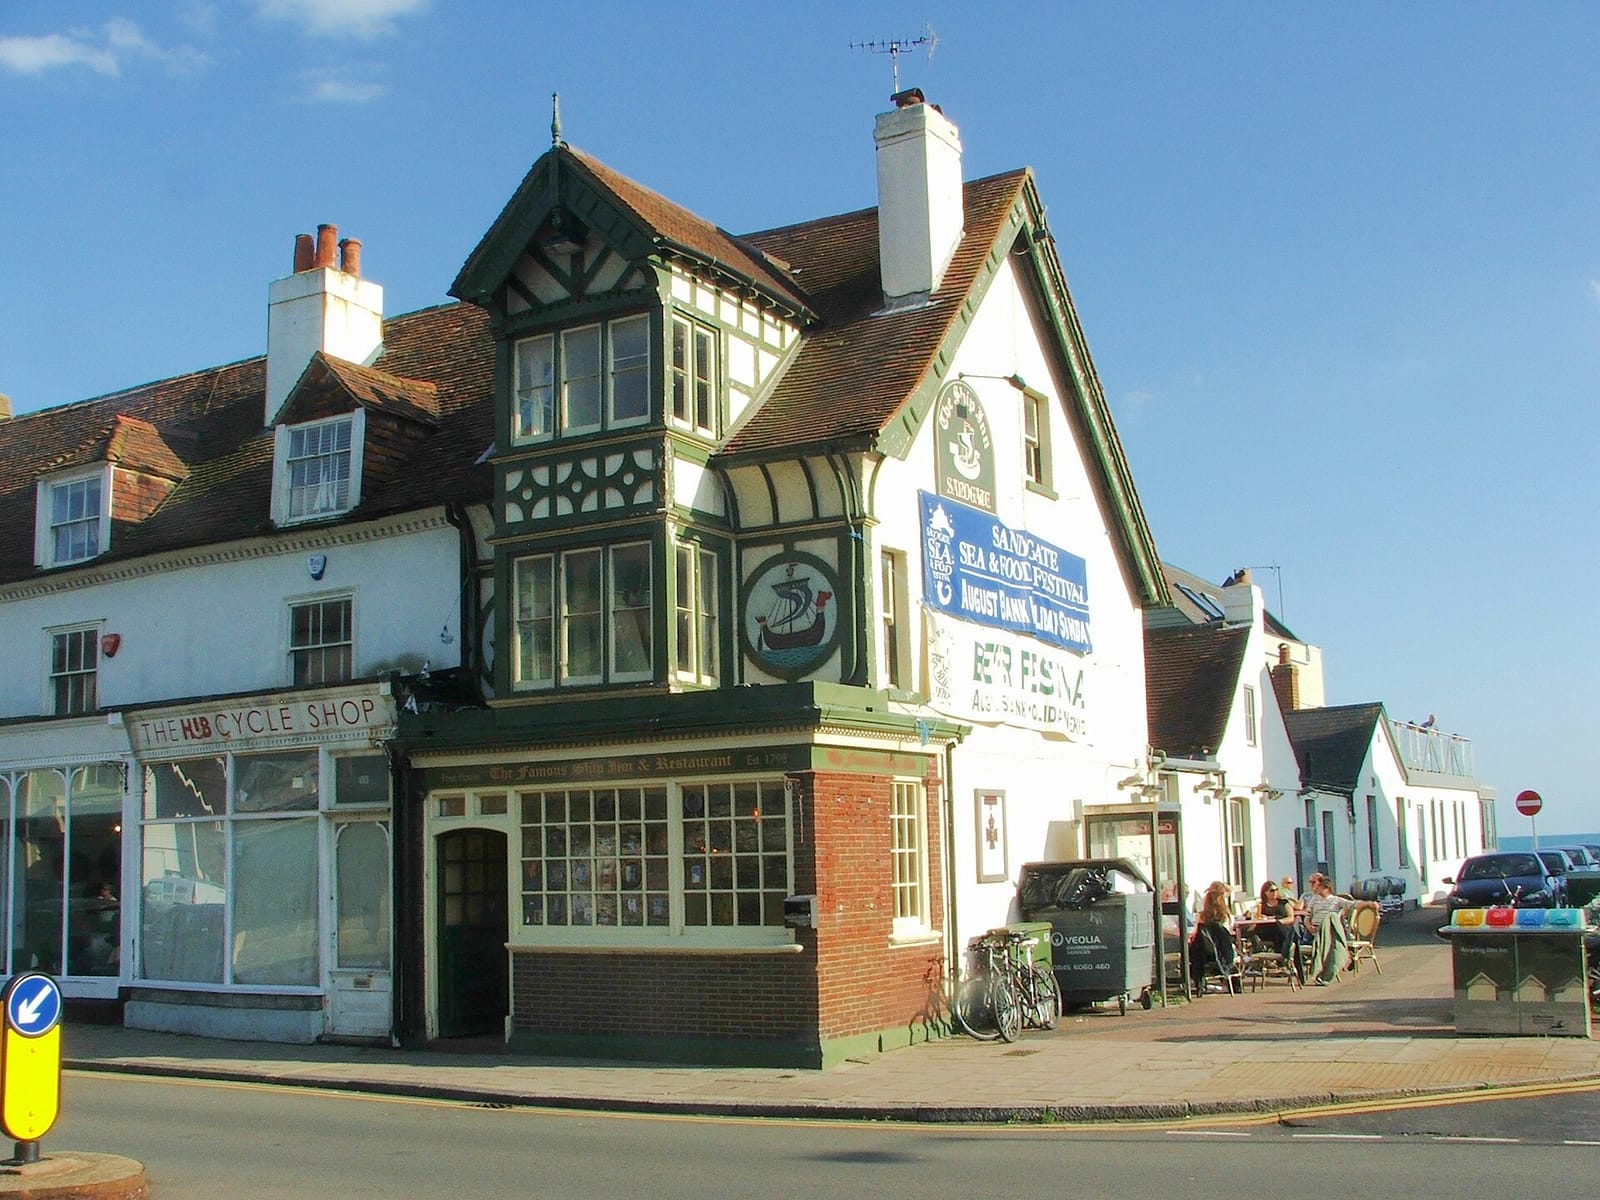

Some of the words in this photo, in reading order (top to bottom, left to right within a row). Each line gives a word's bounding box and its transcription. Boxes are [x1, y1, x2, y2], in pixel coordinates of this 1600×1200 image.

[939, 397, 954, 430] The
[953, 384, 976, 413] Ship
[975, 407, 991, 449] Inn
[992, 525, 1059, 573] SANDGATE
[959, 540, 986, 571] SEA
[988, 552, 1000, 574] &
[1000, 554, 1032, 582] FOOD
[1032, 565, 1089, 606] FESTIVAL
[961, 578, 998, 618] AUGUST
[999, 589, 1031, 624] BANK
[973, 640, 1012, 688] BER
[141, 718, 181, 746] THE
[180, 715, 213, 741] HUB
[214, 706, 294, 738] CYCLE
[307, 699, 375, 728] SHOP
[490, 766, 513, 780] The
[516, 764, 569, 781] Famous
[572, 760, 604, 777] Ship
[608, 759, 634, 774] Inn
[637, 759, 651, 771] &
[655, 754, 734, 770] Restaurant
[1064, 935, 1101, 945] VEOLIA
